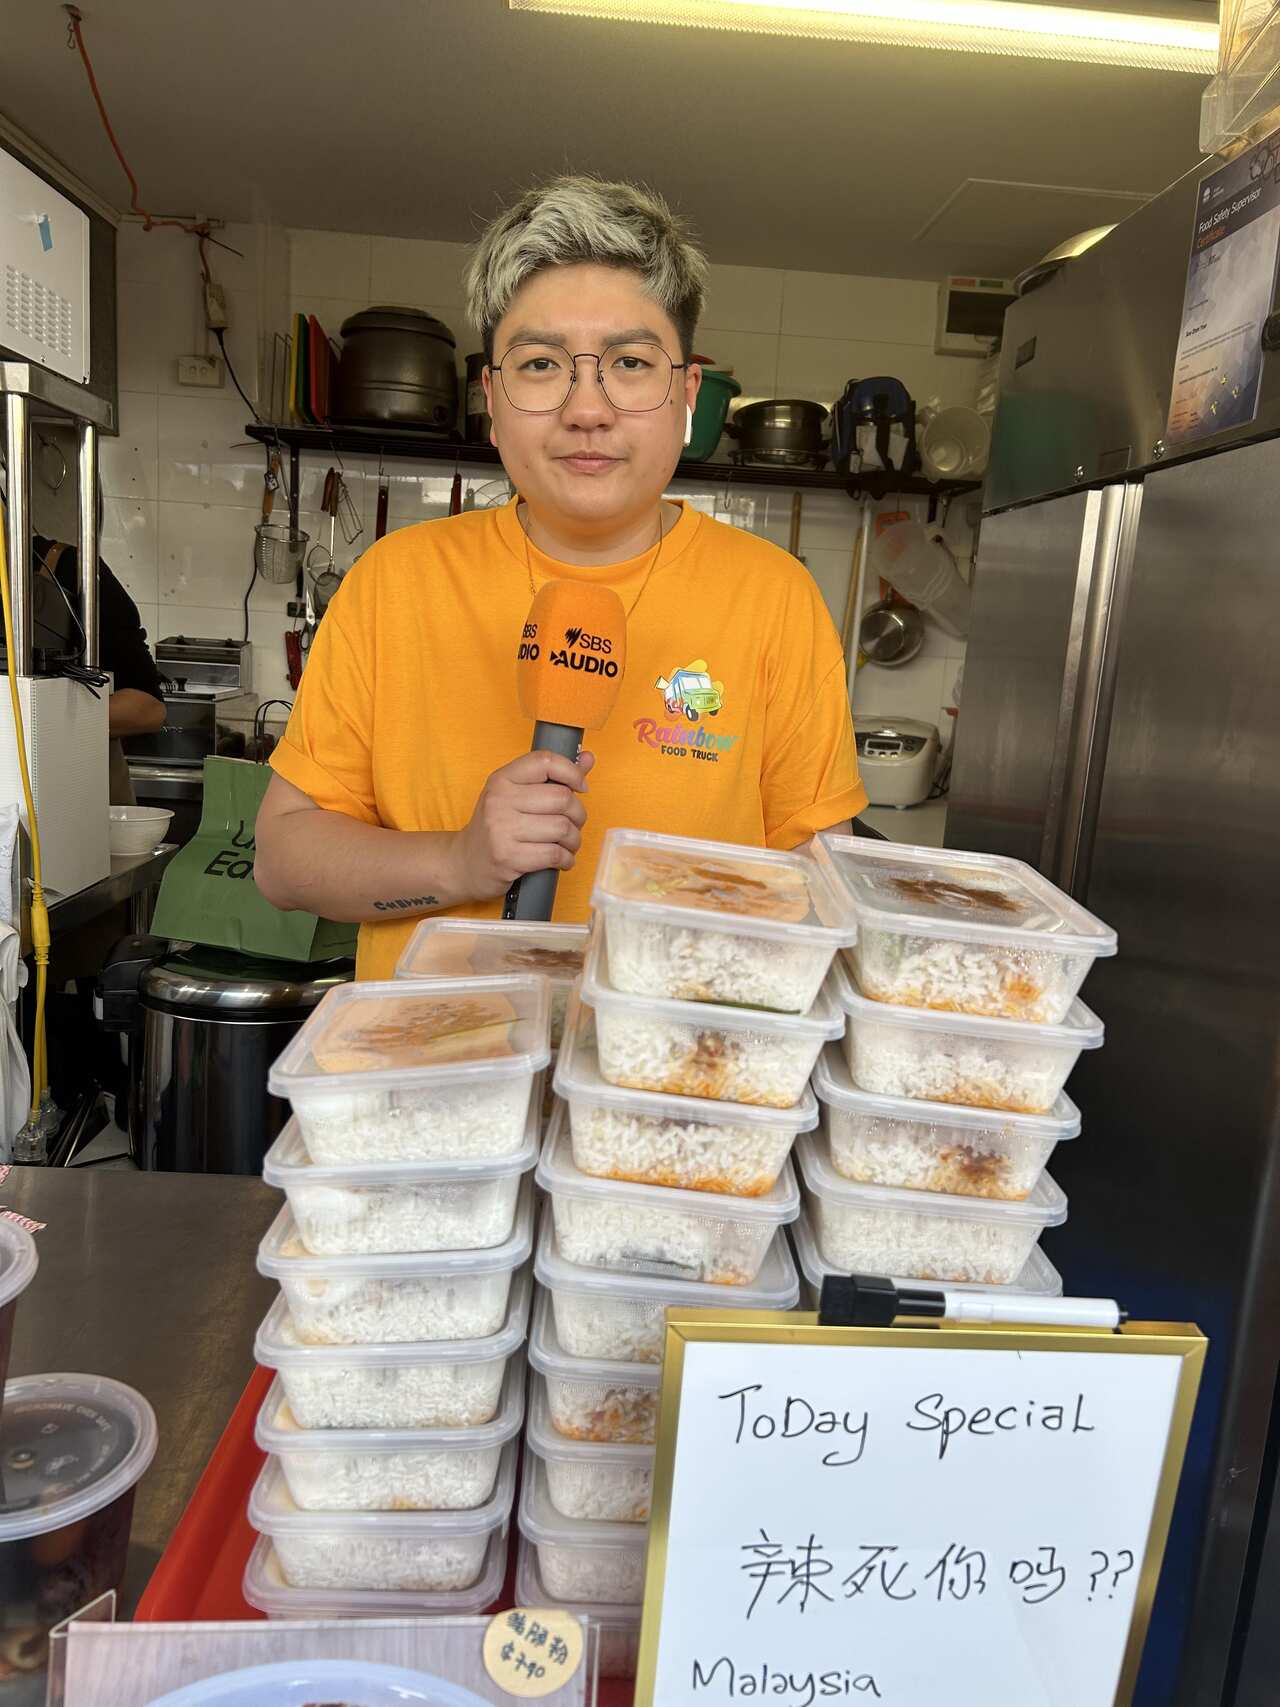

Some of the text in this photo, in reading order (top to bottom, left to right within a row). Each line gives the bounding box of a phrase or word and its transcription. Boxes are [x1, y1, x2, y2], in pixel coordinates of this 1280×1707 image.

[1198, 217, 1213, 234] Food
[1213, 207, 1231, 226] Safety
[1231, 187, 1263, 214] Supervisor
[579, 633, 612, 654] SBS
[553, 650, 618, 678] AUDIO
[632, 718, 740, 753] Rainbow
[661, 744, 719, 762] FOOD TRUCK
[204, 850, 255, 880] Ea
[692, 1657, 882, 1707] Malaysia
